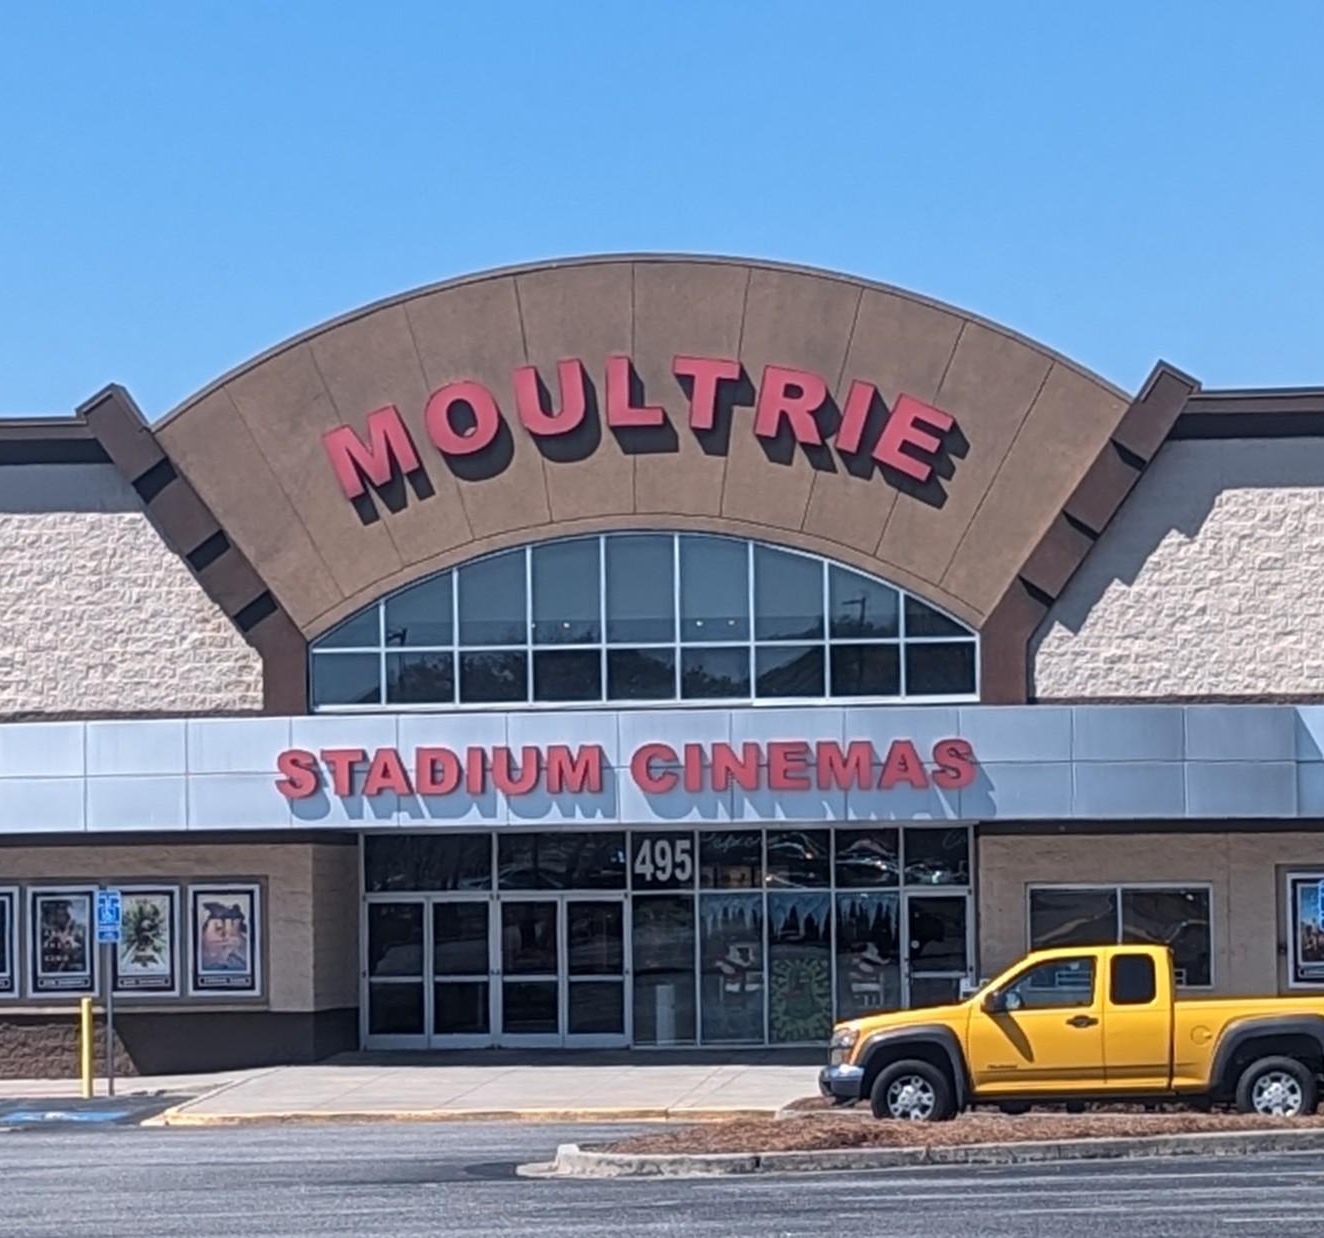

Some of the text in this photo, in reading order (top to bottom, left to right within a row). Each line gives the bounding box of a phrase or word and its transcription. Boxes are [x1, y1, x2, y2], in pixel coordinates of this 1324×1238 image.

[322, 355, 955, 499] MOULTRIE
[277, 739, 976, 798] STADIUM CINEMAS
[634, 839, 692, 881] 495
